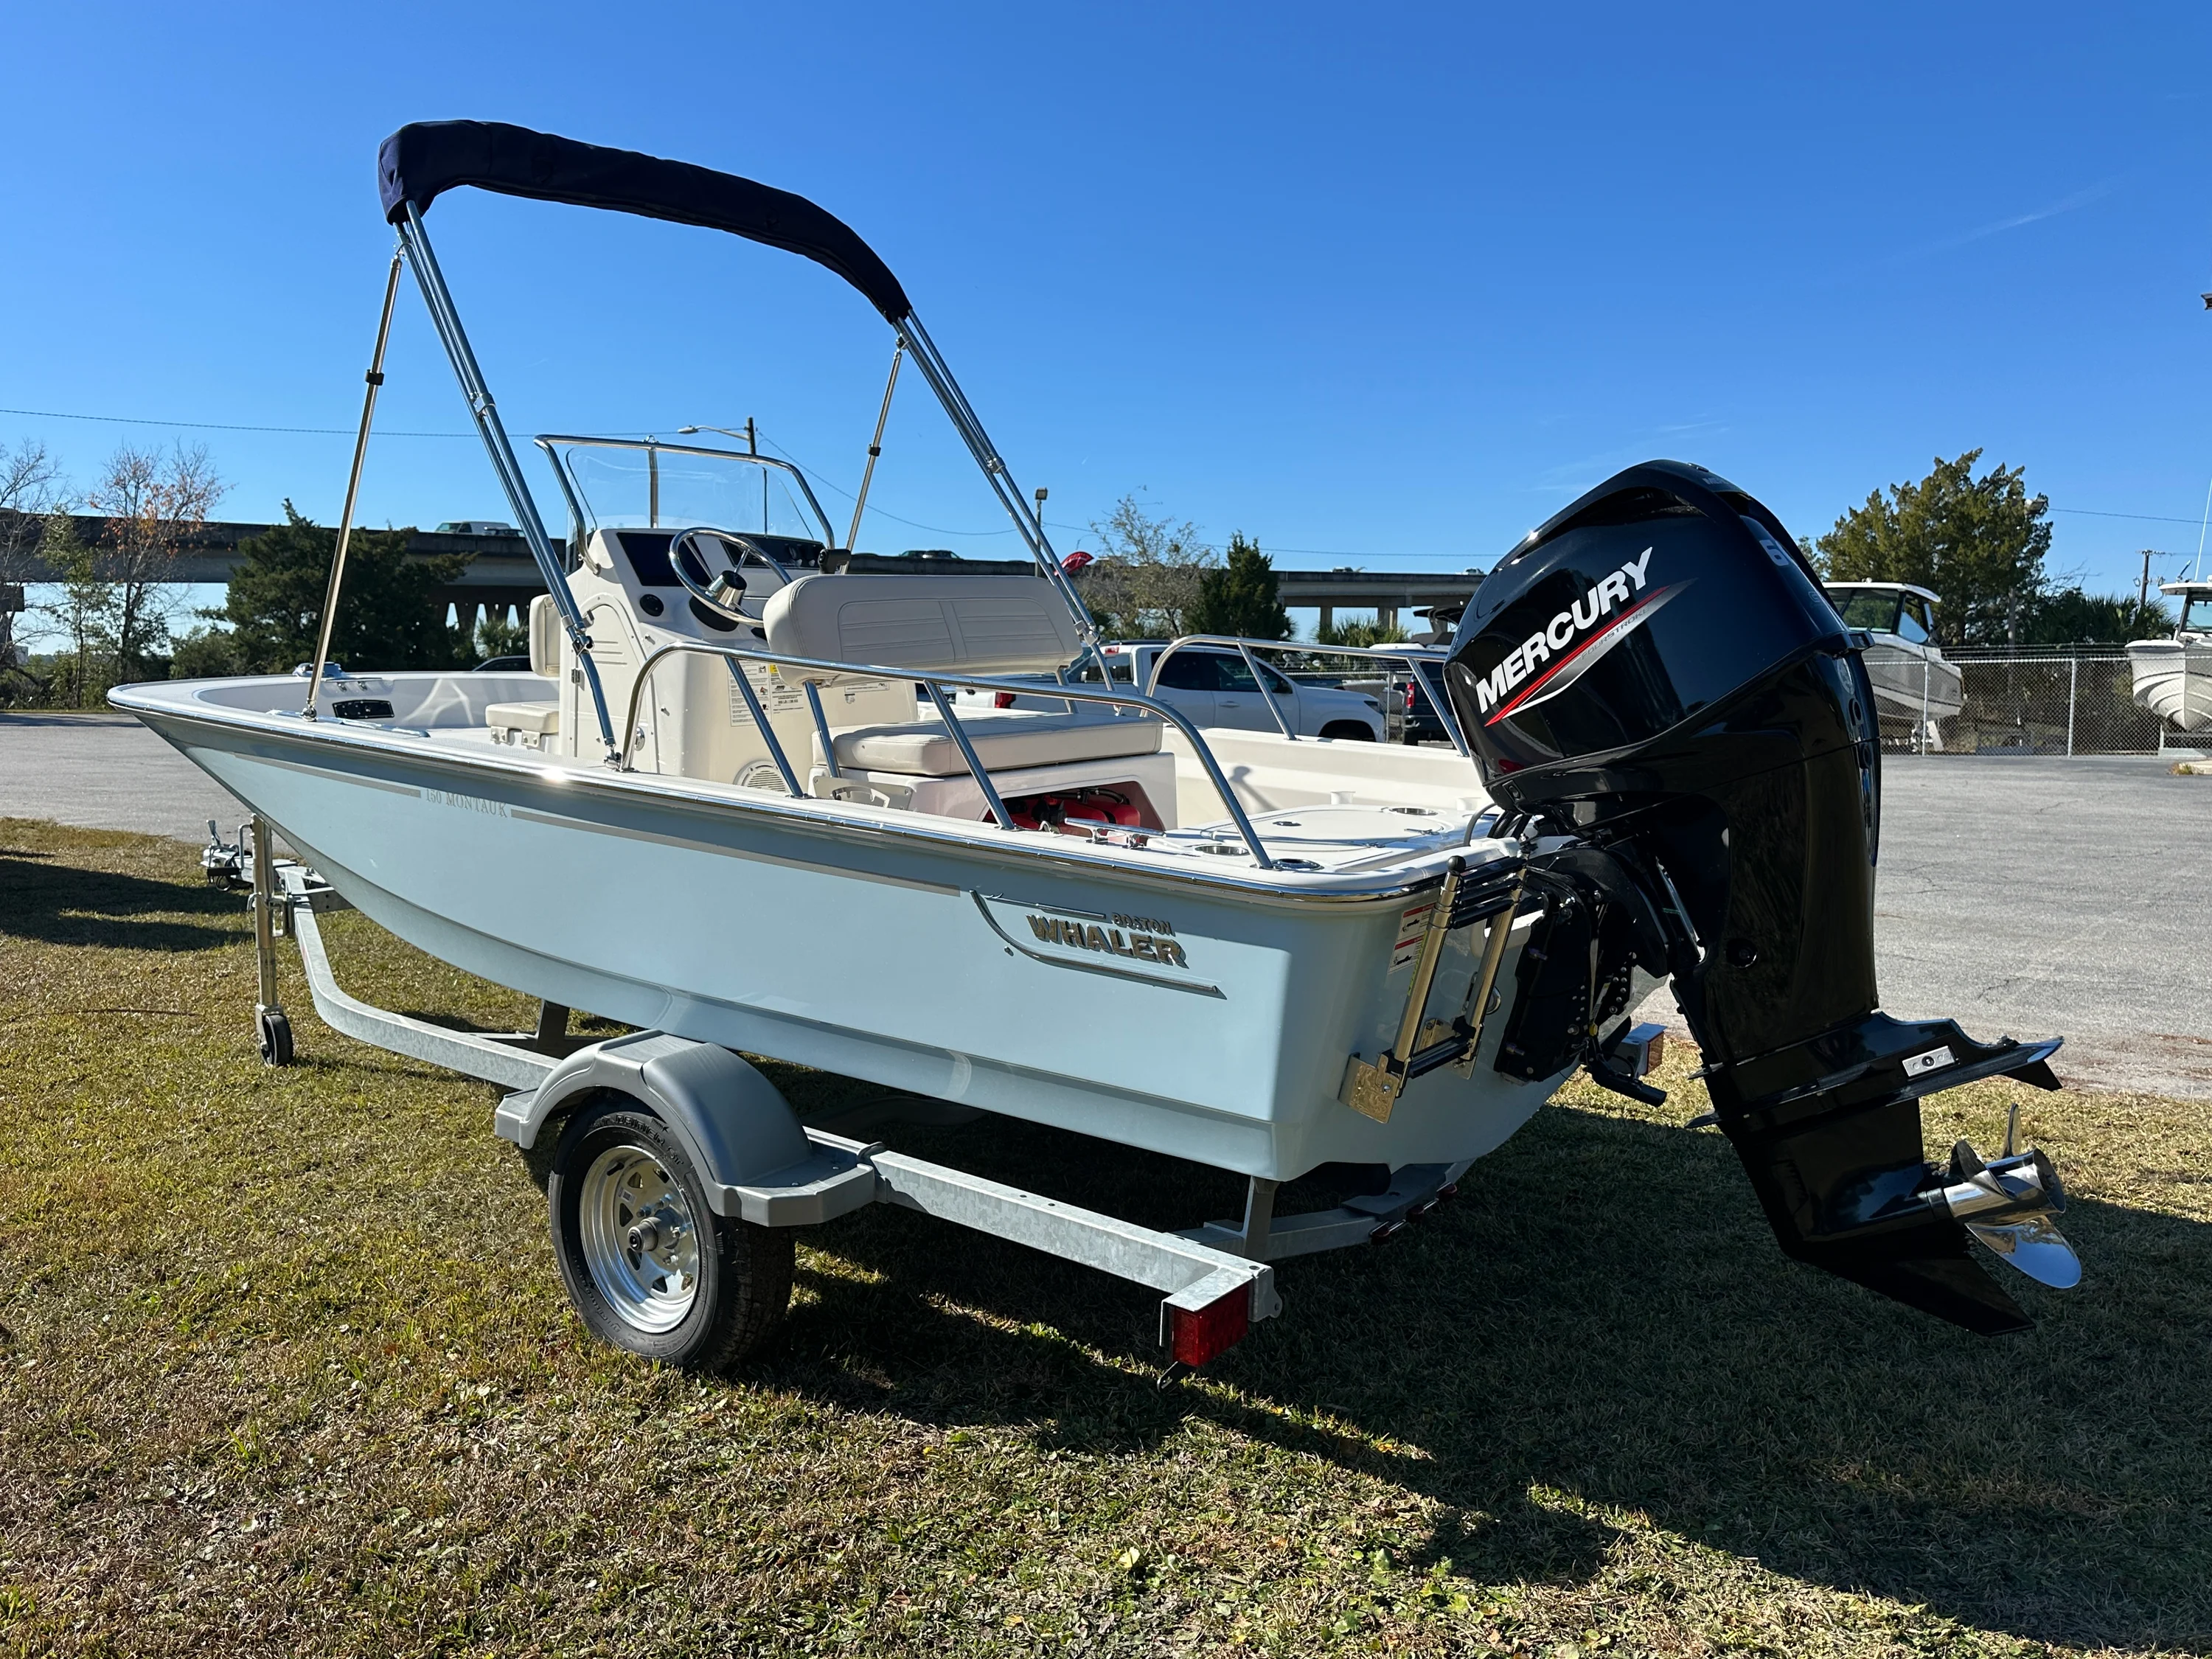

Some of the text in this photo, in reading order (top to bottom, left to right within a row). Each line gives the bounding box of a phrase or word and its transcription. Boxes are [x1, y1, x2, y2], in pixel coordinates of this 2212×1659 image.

[1476, 547, 1652, 714] MERCURY
[1581, 605, 1649, 660] FOURSTROKE
[426, 789, 507, 818] 150 MONTAUK
[1026, 914, 1190, 969] WHALER
[1112, 912, 1176, 937] BOSTON
